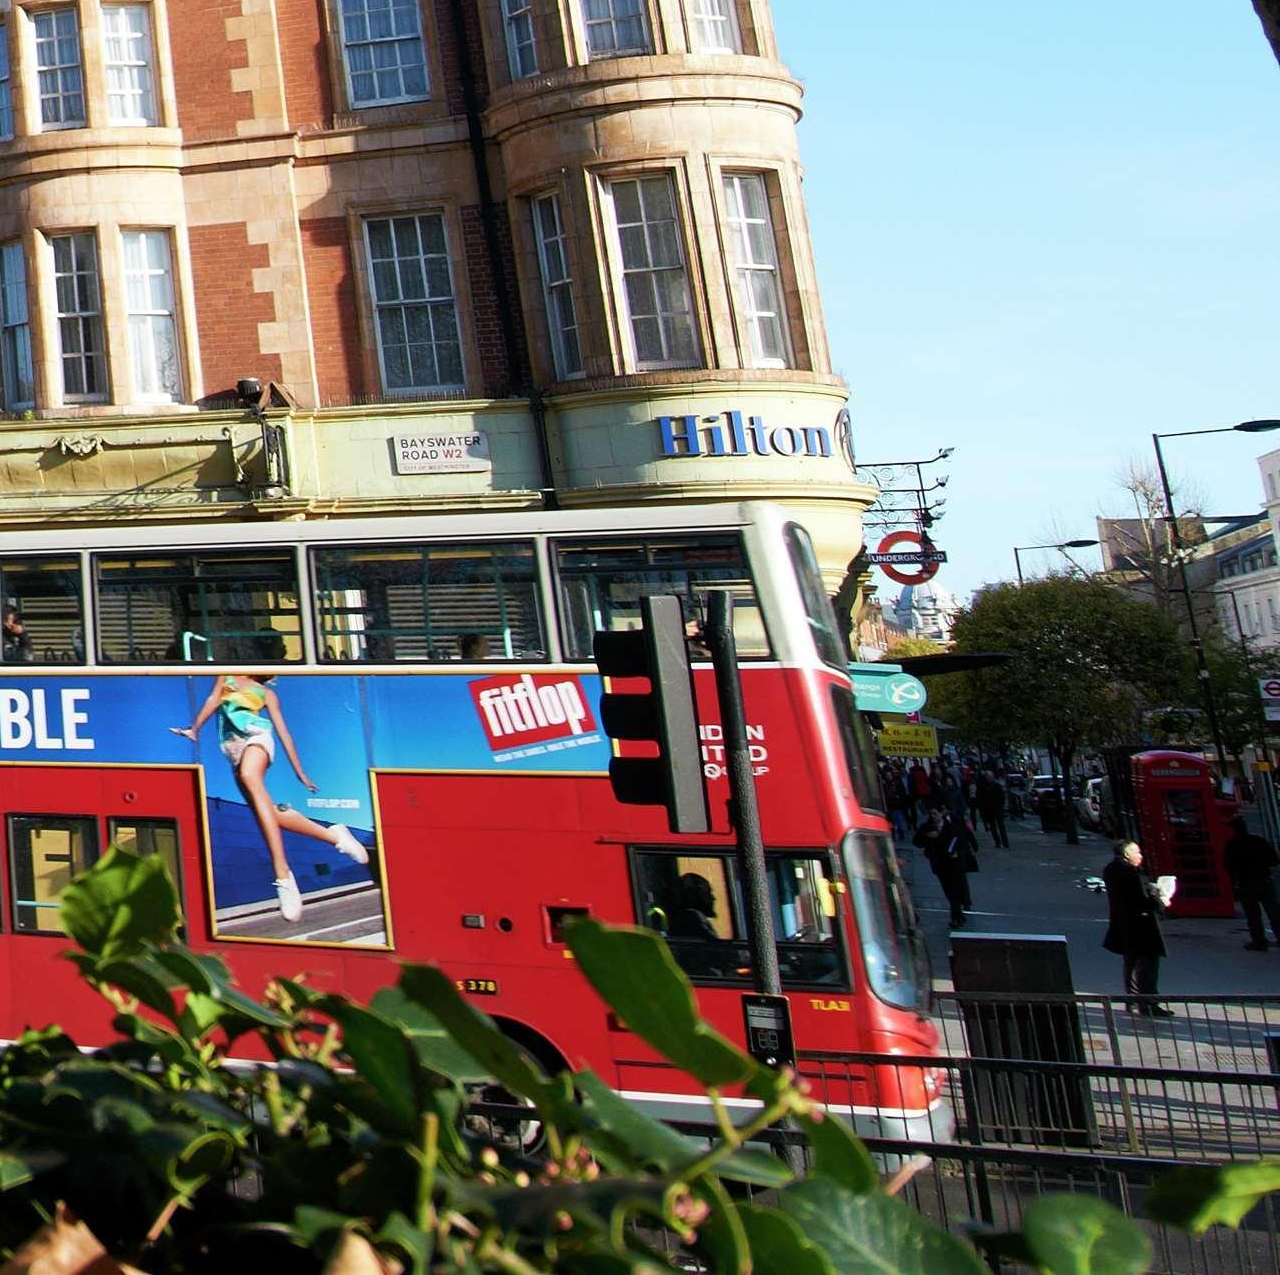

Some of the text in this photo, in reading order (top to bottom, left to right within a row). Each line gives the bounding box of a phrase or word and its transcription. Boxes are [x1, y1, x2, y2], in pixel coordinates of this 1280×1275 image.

[400, 436, 481, 448] BAYSWATER
[655, 410, 834, 457] Hilton
[402, 449, 462, 461] ROAD W2
[479, 674, 587, 737] fitflop
